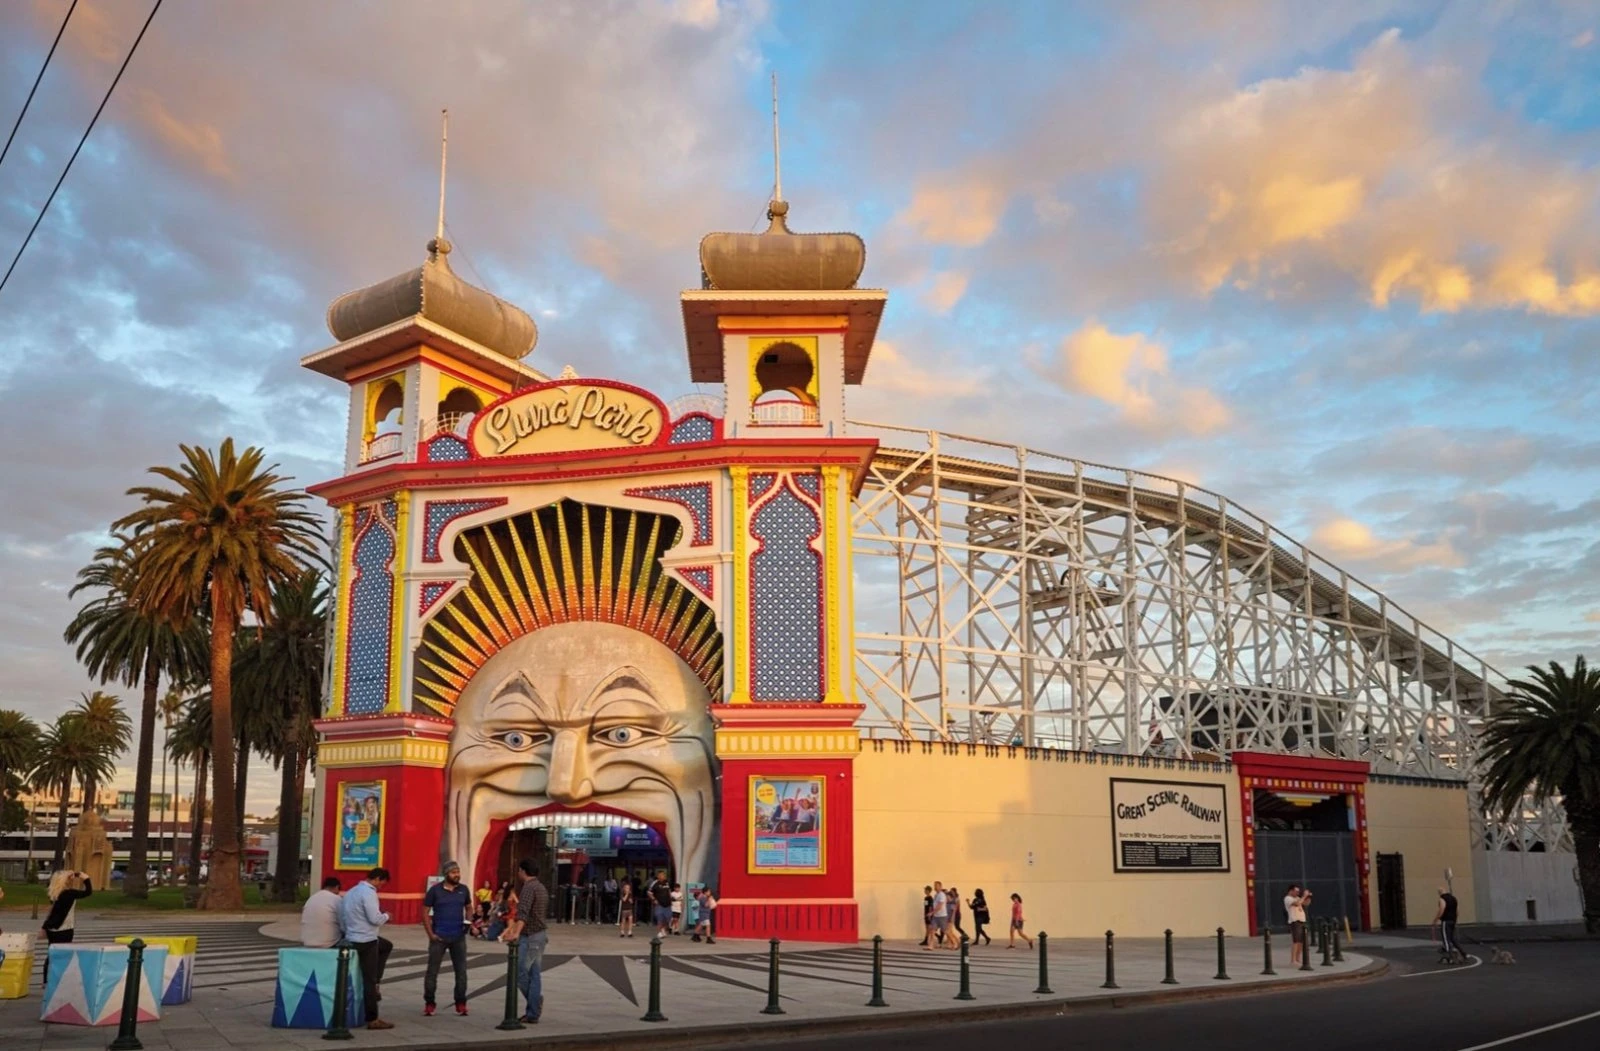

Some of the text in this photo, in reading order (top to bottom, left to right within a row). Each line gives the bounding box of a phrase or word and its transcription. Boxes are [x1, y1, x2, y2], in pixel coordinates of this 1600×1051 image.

[485, 386, 654, 454] Luna Park
[1117, 790, 1222, 823] GREAT SCENIC RAILWAY
